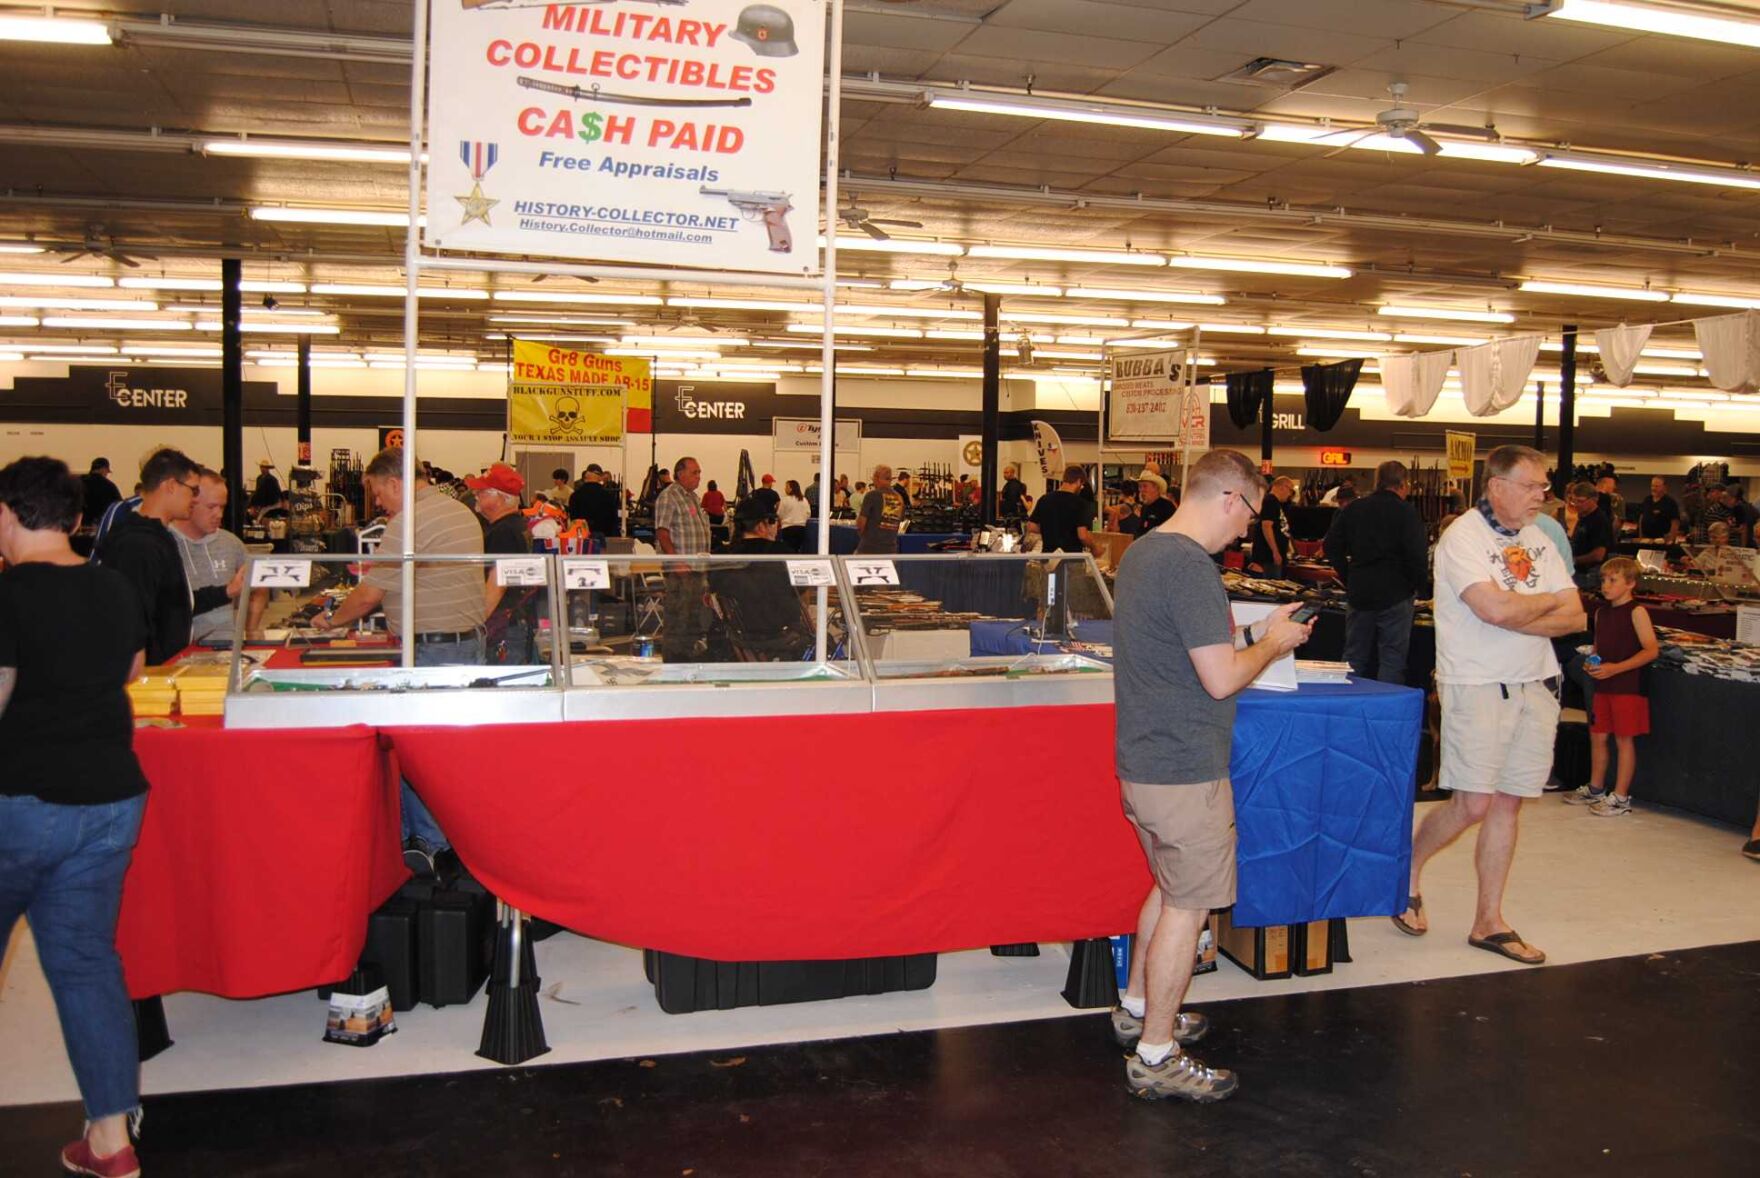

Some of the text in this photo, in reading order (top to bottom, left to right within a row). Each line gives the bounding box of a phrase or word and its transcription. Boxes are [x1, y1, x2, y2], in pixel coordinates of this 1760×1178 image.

[541, 3, 727, 48] MILITARY
[486, 38, 777, 94] COLLECTIBLES
[517, 106, 745, 155] CA$H PAID
[539, 151, 719, 183] Free Appraisals
[514, 200, 740, 231] HISTORY-COLLECTOR.NET
[516, 362, 565, 383] TEXAS
[569, 370, 608, 385] MADE
[548, 348, 623, 372] Gr8 Guns
[117, 389, 188, 408] CENTER
[513, 387, 621, 397] BLACKGUNSTUFF.COM
[685, 402, 745, 419] CENTER
[1033, 423, 1048, 474] KNIVES
